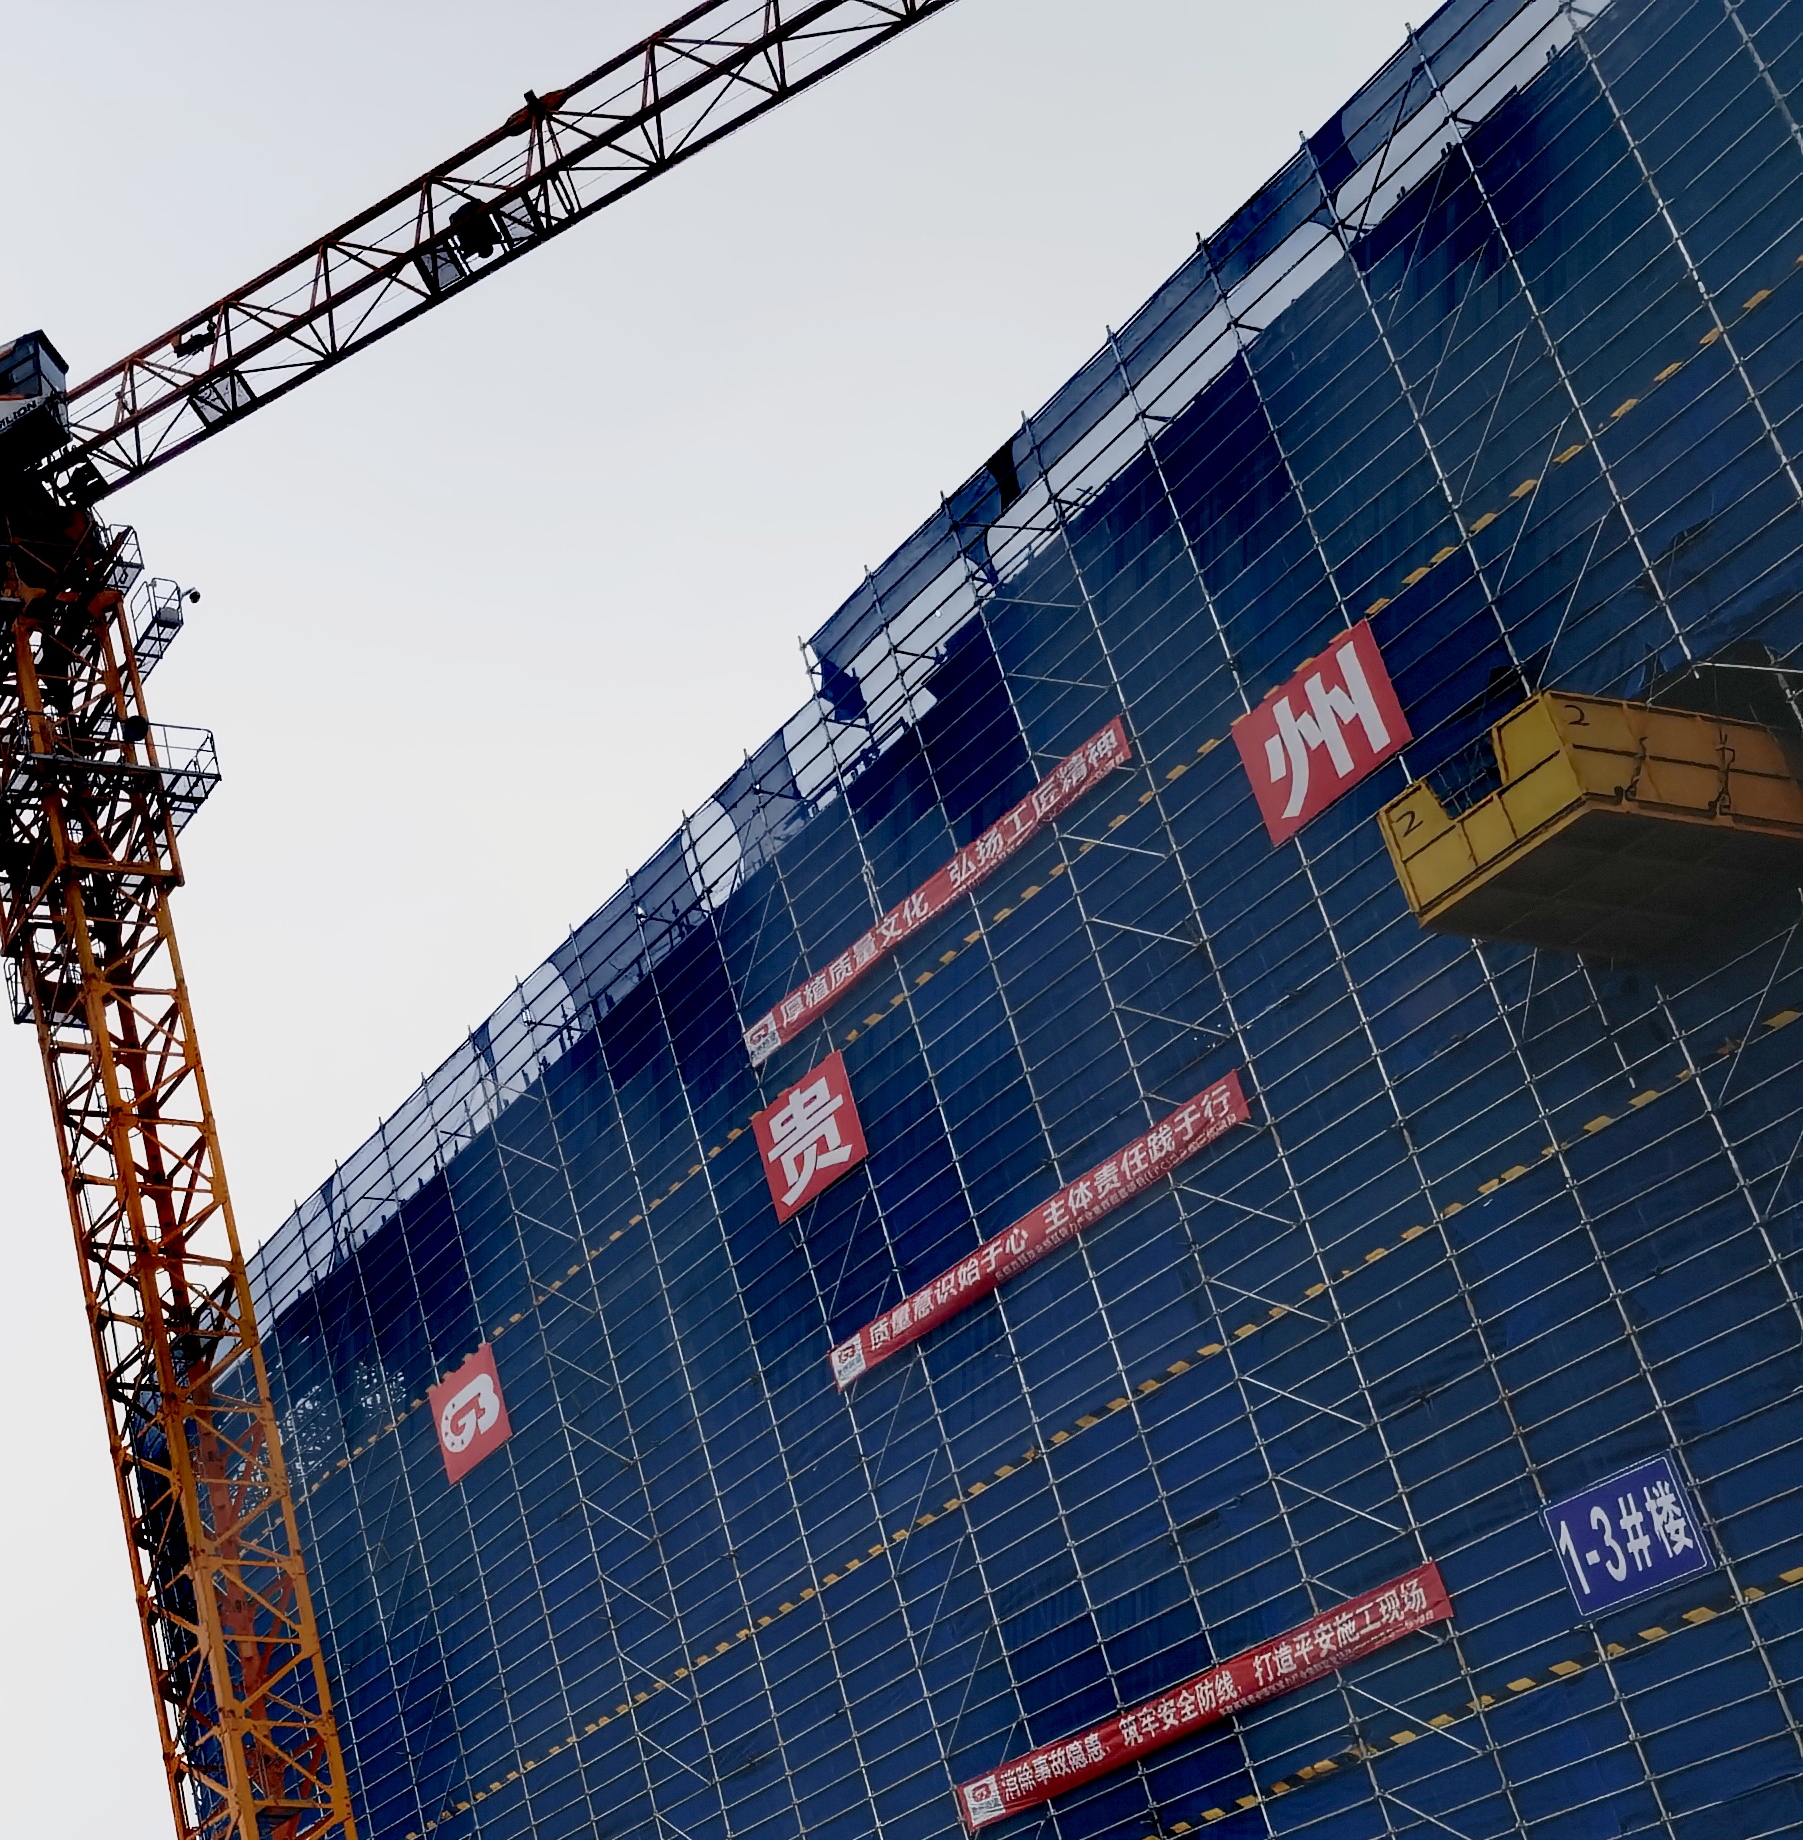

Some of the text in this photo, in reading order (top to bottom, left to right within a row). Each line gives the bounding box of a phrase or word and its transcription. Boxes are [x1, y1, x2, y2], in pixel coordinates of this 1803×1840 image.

[1265, 640, 1391, 818] 州
[767, 1075, 854, 1205] 贵
[870, 1084, 1231, 1350] 质量意识始于心 主体责任践于行
[1557, 1480, 1694, 1595] 1-3#楼
